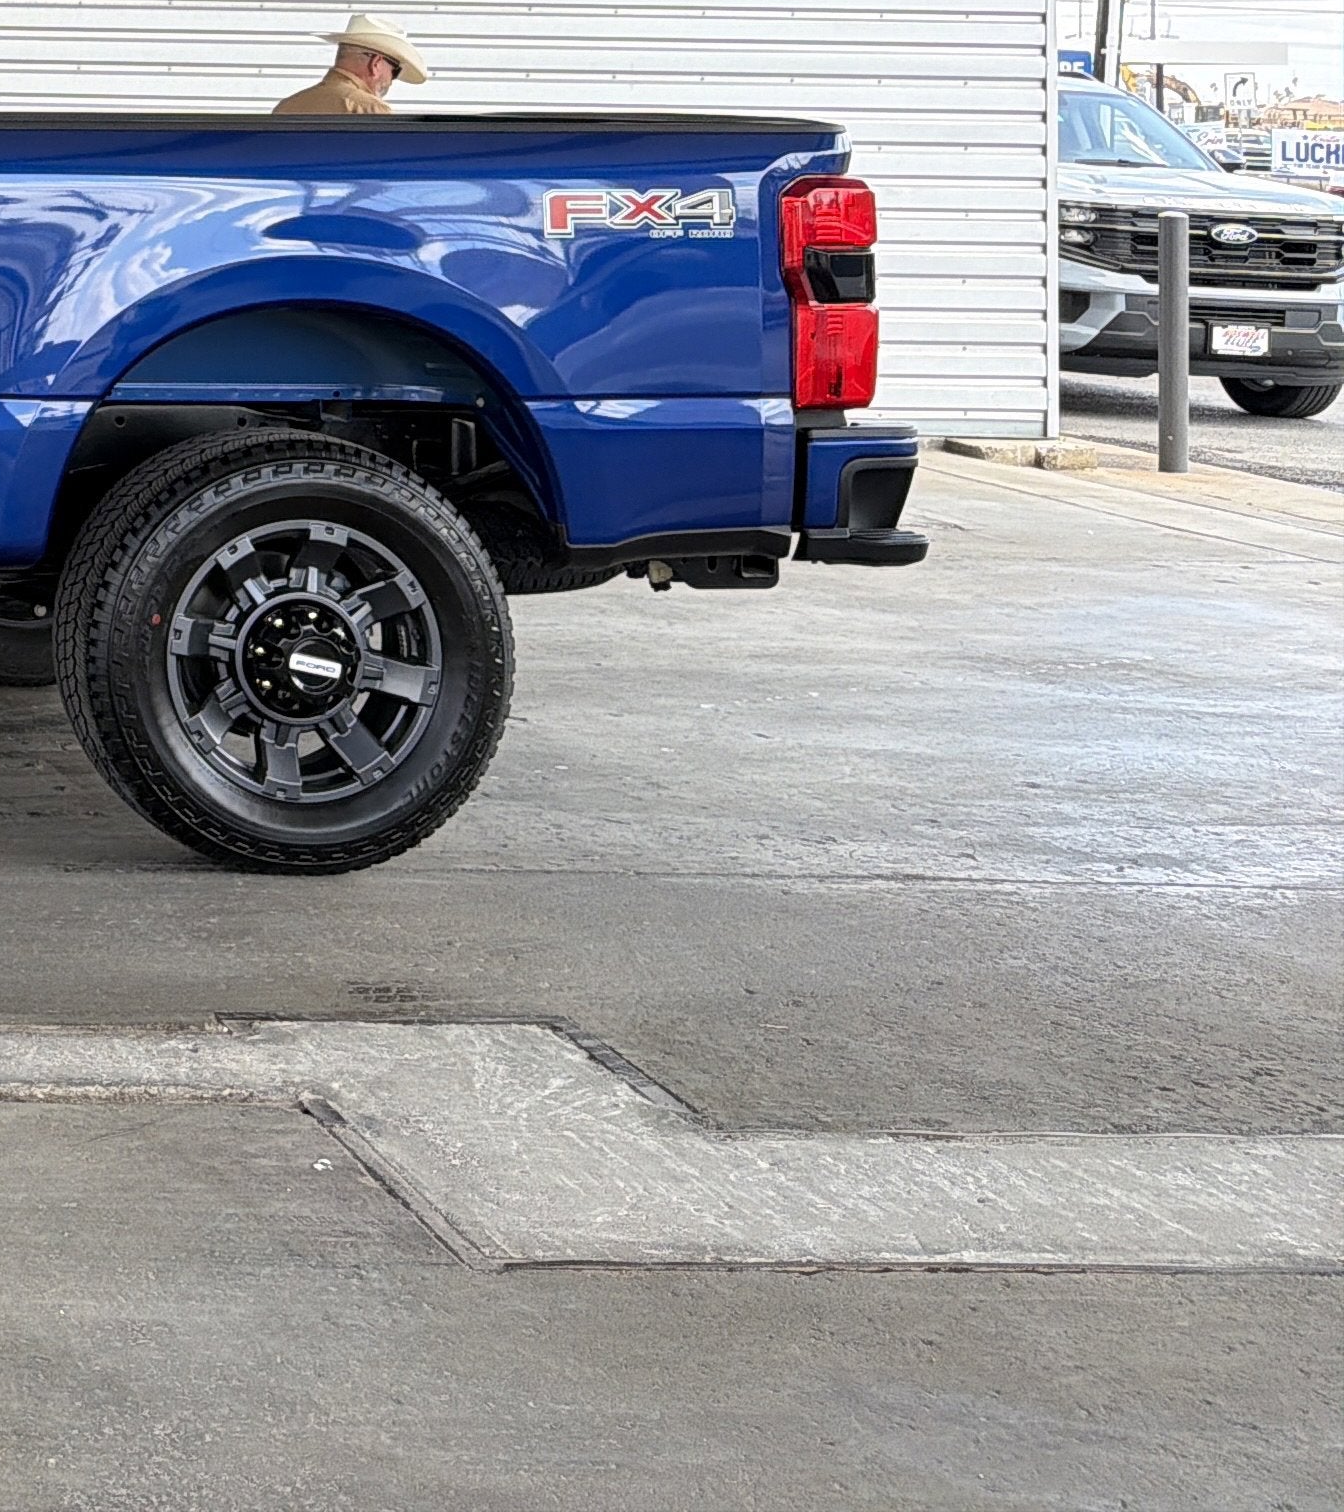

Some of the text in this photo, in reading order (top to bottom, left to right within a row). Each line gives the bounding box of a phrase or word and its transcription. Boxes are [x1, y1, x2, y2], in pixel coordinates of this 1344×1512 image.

[1230, 99, 1253, 107] ONLY
[543, 189, 736, 238] FX4
[295, 660, 336, 674] FORD
